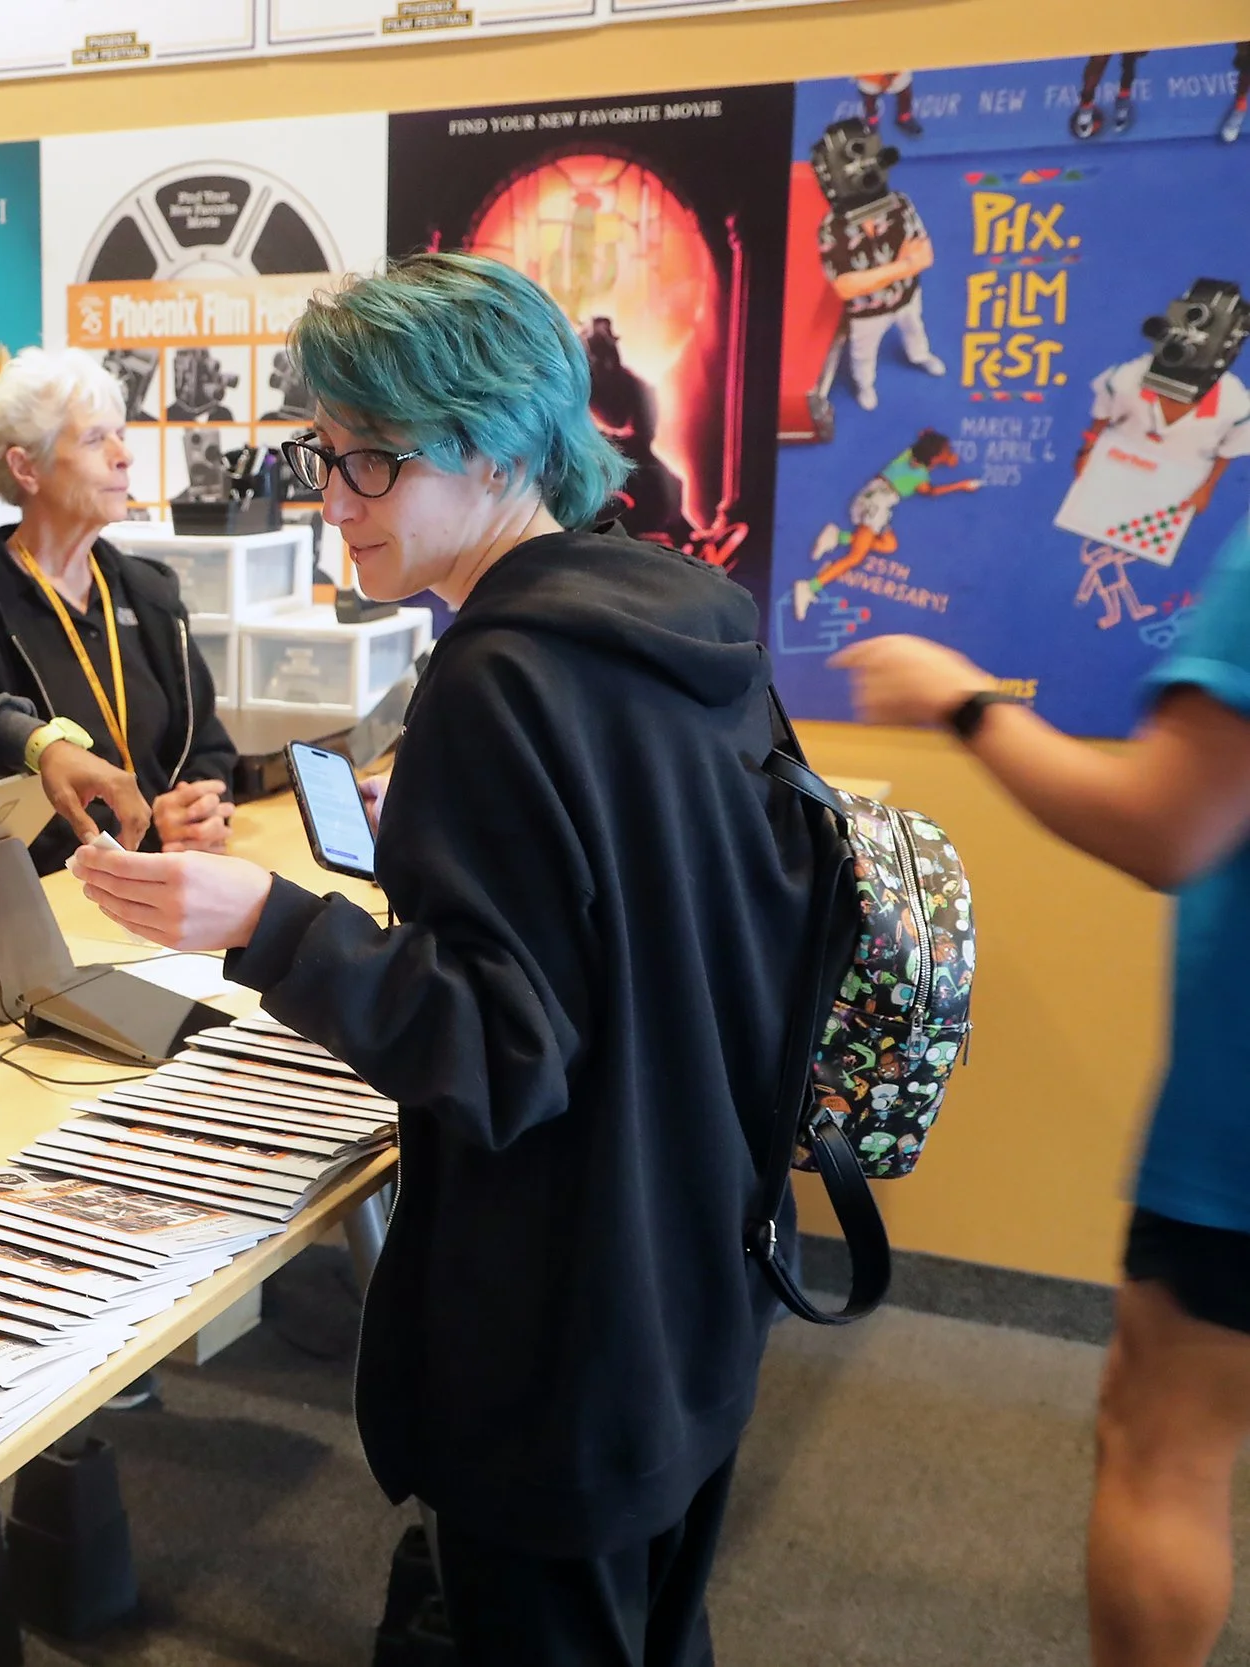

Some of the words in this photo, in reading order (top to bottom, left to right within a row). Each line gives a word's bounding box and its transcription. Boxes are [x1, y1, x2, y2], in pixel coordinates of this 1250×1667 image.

[978, 88, 1027, 113] NEW
[449, 117, 488, 136] FIND
[490, 114, 536, 133] YOUR
[538, 111, 577, 129] NEW
[579, 105, 660, 127] FAVORITE
[663, 100, 722, 120] MOVIE
[972, 191, 1082, 255] PHX.
[110, 292, 198, 338] Phoenix
[202, 291, 249, 336] Film
[960, 416, 1023, 438] MARCH
[1028, 415, 1054, 440] 27
[950, 440, 978, 464] TO
[985, 440, 1037, 463] APRIL
[864, 555, 911, 580] 25TH
